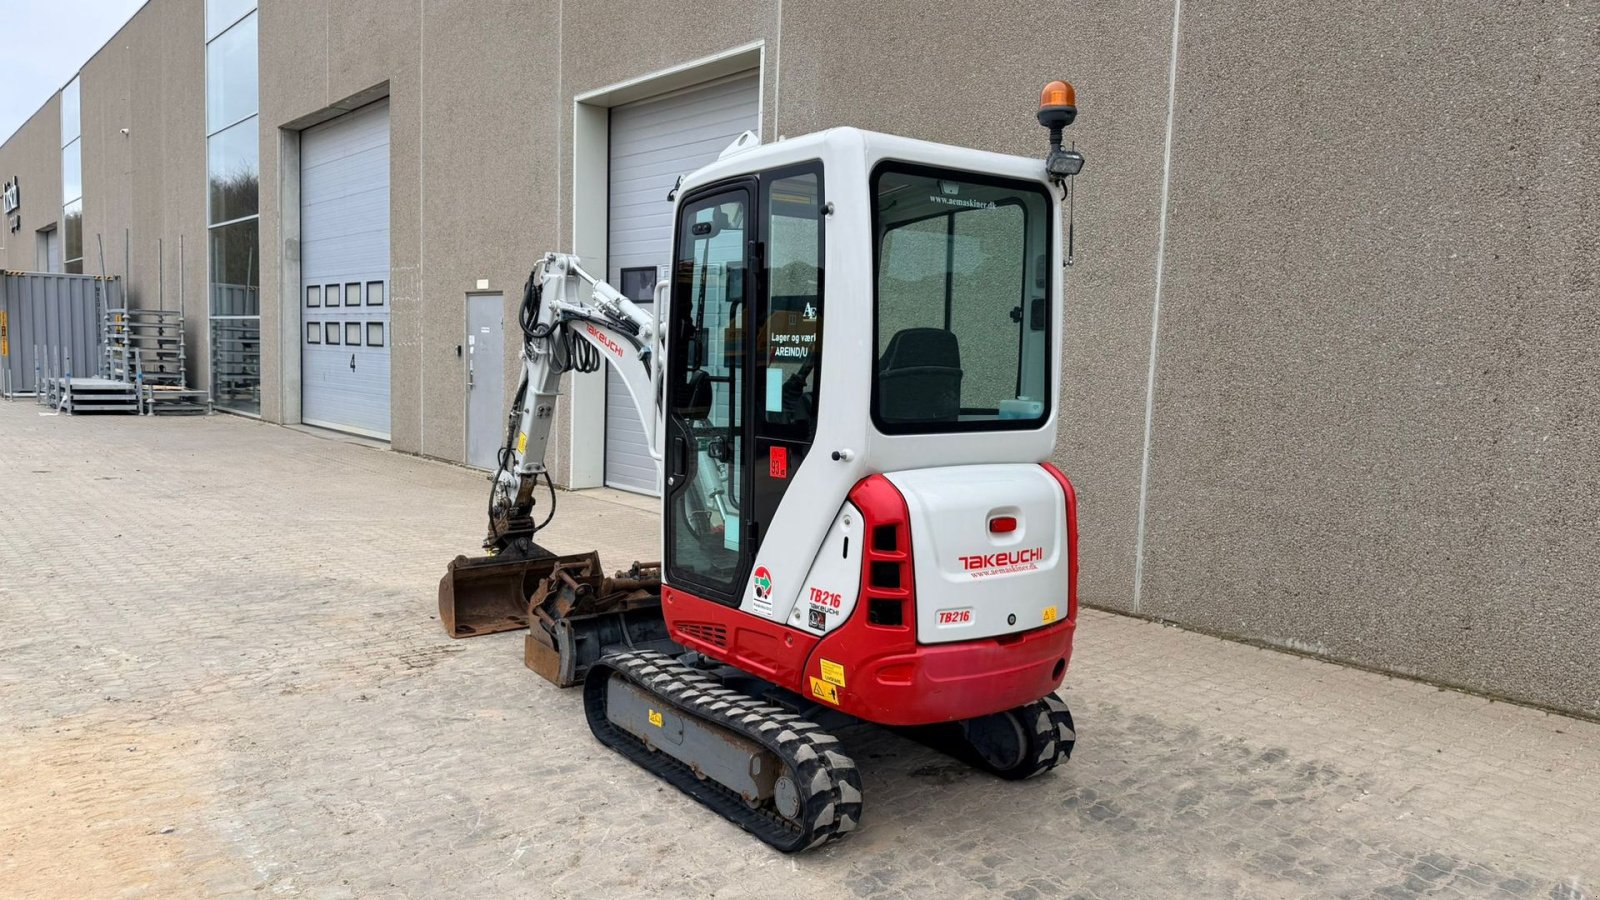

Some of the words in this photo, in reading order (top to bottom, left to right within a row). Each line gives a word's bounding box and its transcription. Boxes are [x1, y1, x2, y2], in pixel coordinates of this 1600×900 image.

[771, 332, 790, 343] Lager
[791, 334, 800, 344] og
[775, 346, 808, 358] AREIND/U
[350, 353, 356, 373] 4
[958, 547, 1042, 570] TAKEUCHI
[971, 563, 1038, 578] www.aemaskiner.dk
[810, 587, 841, 608] TB216
[809, 602, 840, 616] TAKEUCHI
[939, 610, 971, 624] TB216
